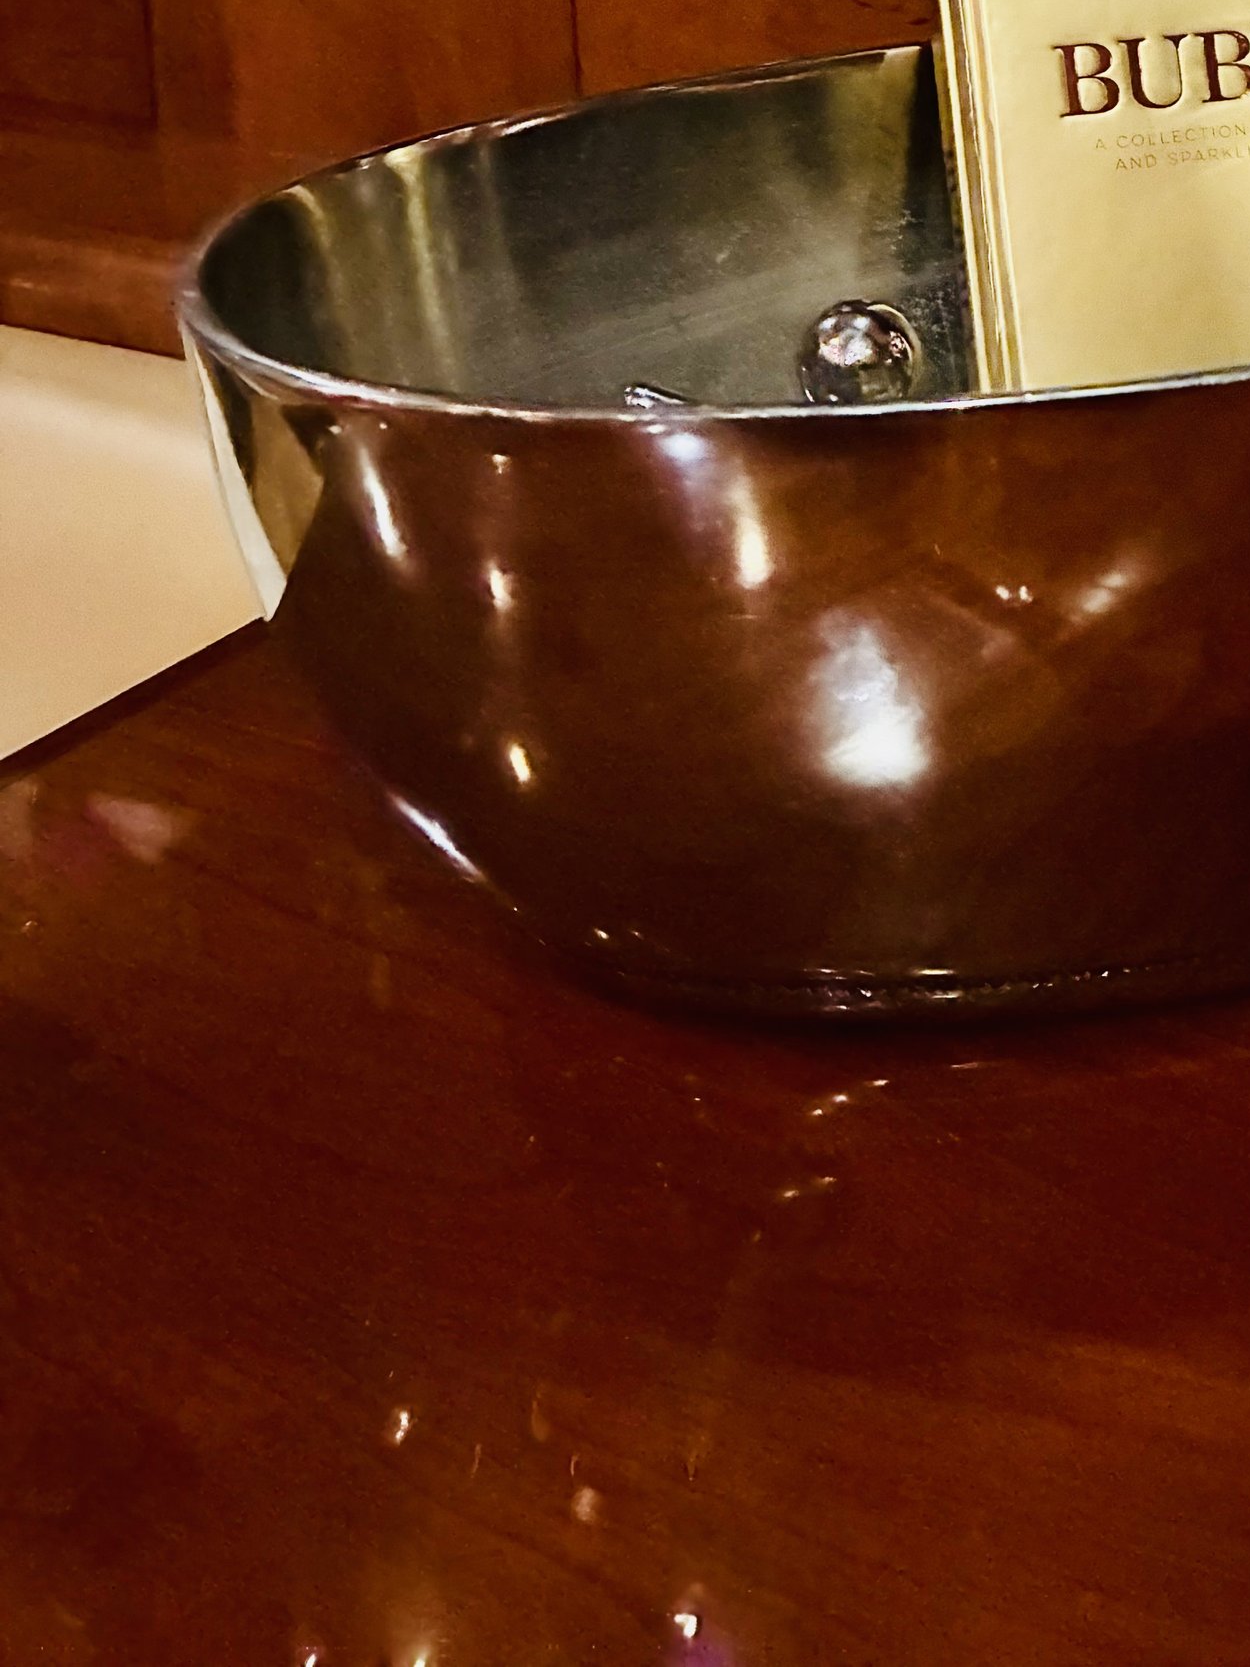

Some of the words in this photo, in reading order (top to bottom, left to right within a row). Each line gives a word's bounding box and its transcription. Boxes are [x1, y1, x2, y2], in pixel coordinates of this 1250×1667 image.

[1095, 137, 1108, 151] A
[1115, 123, 1247, 150] COLLECTION
[1115, 153, 1158, 171] AND
